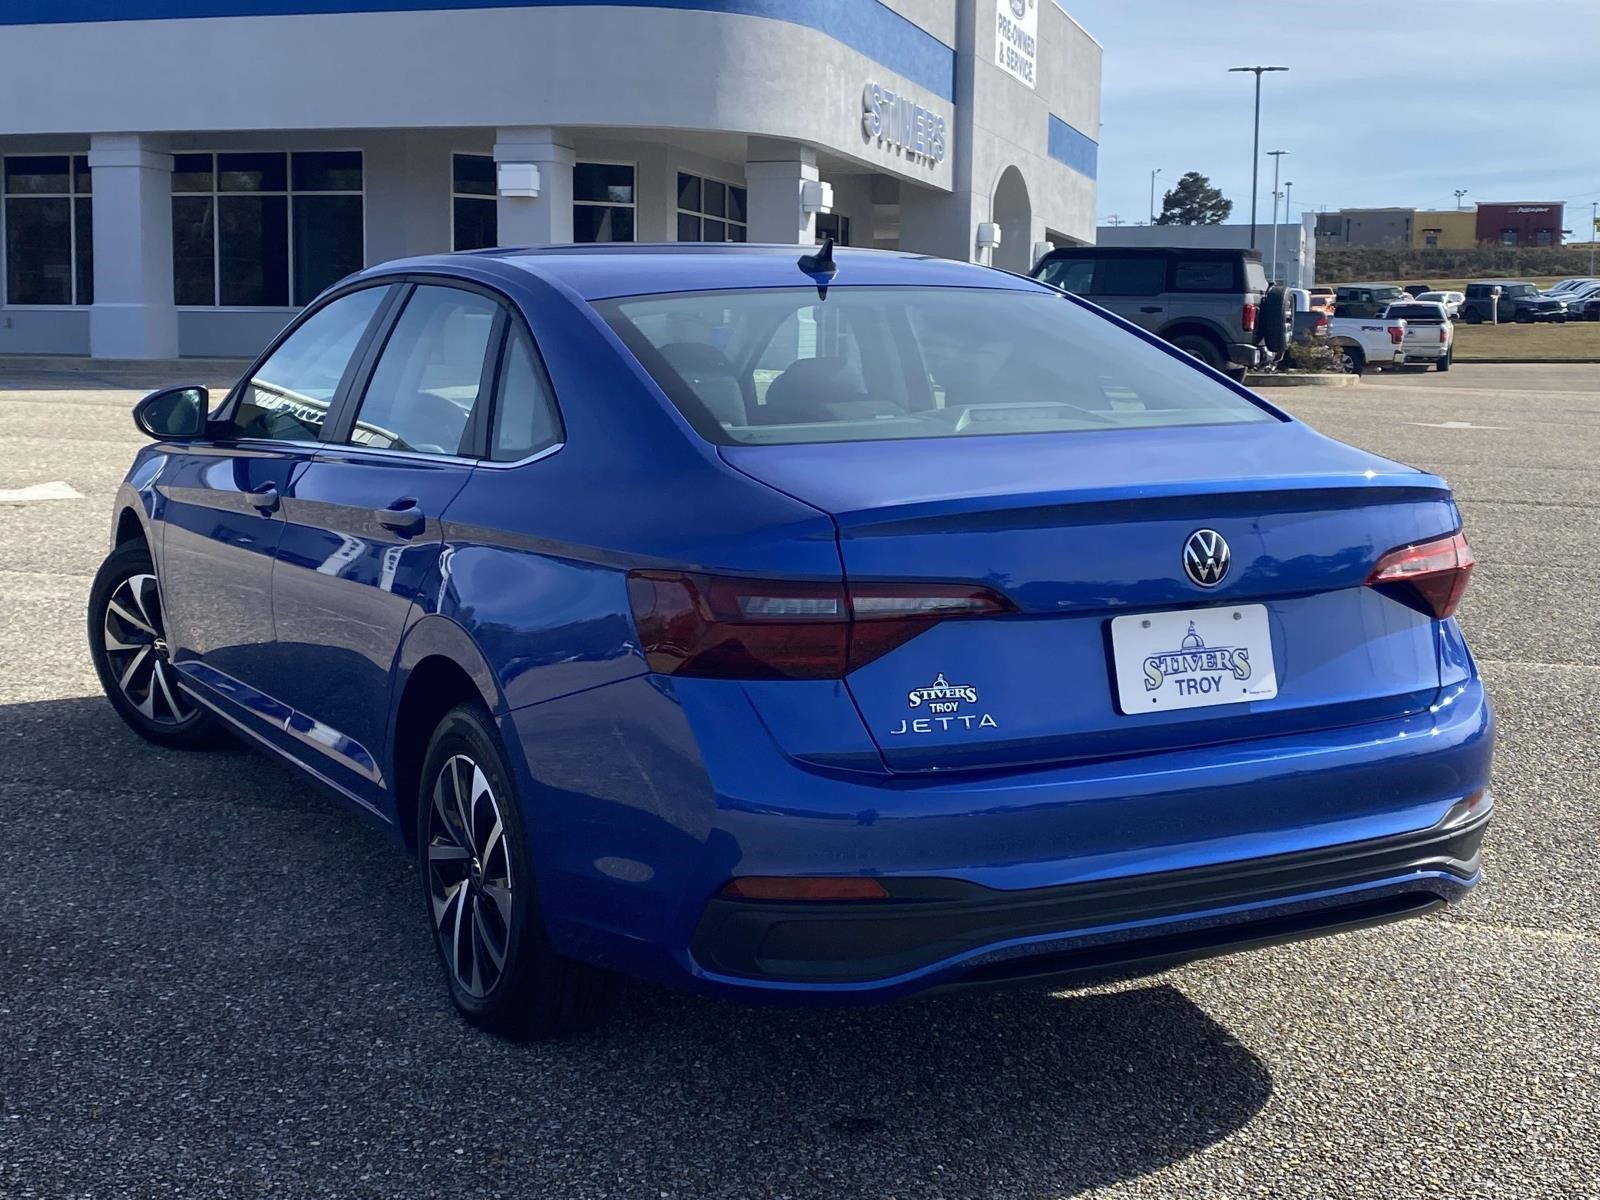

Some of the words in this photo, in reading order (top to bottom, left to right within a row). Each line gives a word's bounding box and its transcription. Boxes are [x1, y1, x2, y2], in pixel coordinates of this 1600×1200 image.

[998, 12, 1035, 58] PRE-OWNED
[999, 41, 1004, 64] &
[1006, 46, 1033, 83] SERVICE
[864, 82, 945, 163] STIVERS
[1143, 648, 1251, 691] STIVERS
[908, 687, 977, 707] STIVERS
[1175, 676, 1223, 695] TROY
[929, 702, 959, 713] TROY
[890, 713, 998, 734] JETTA
